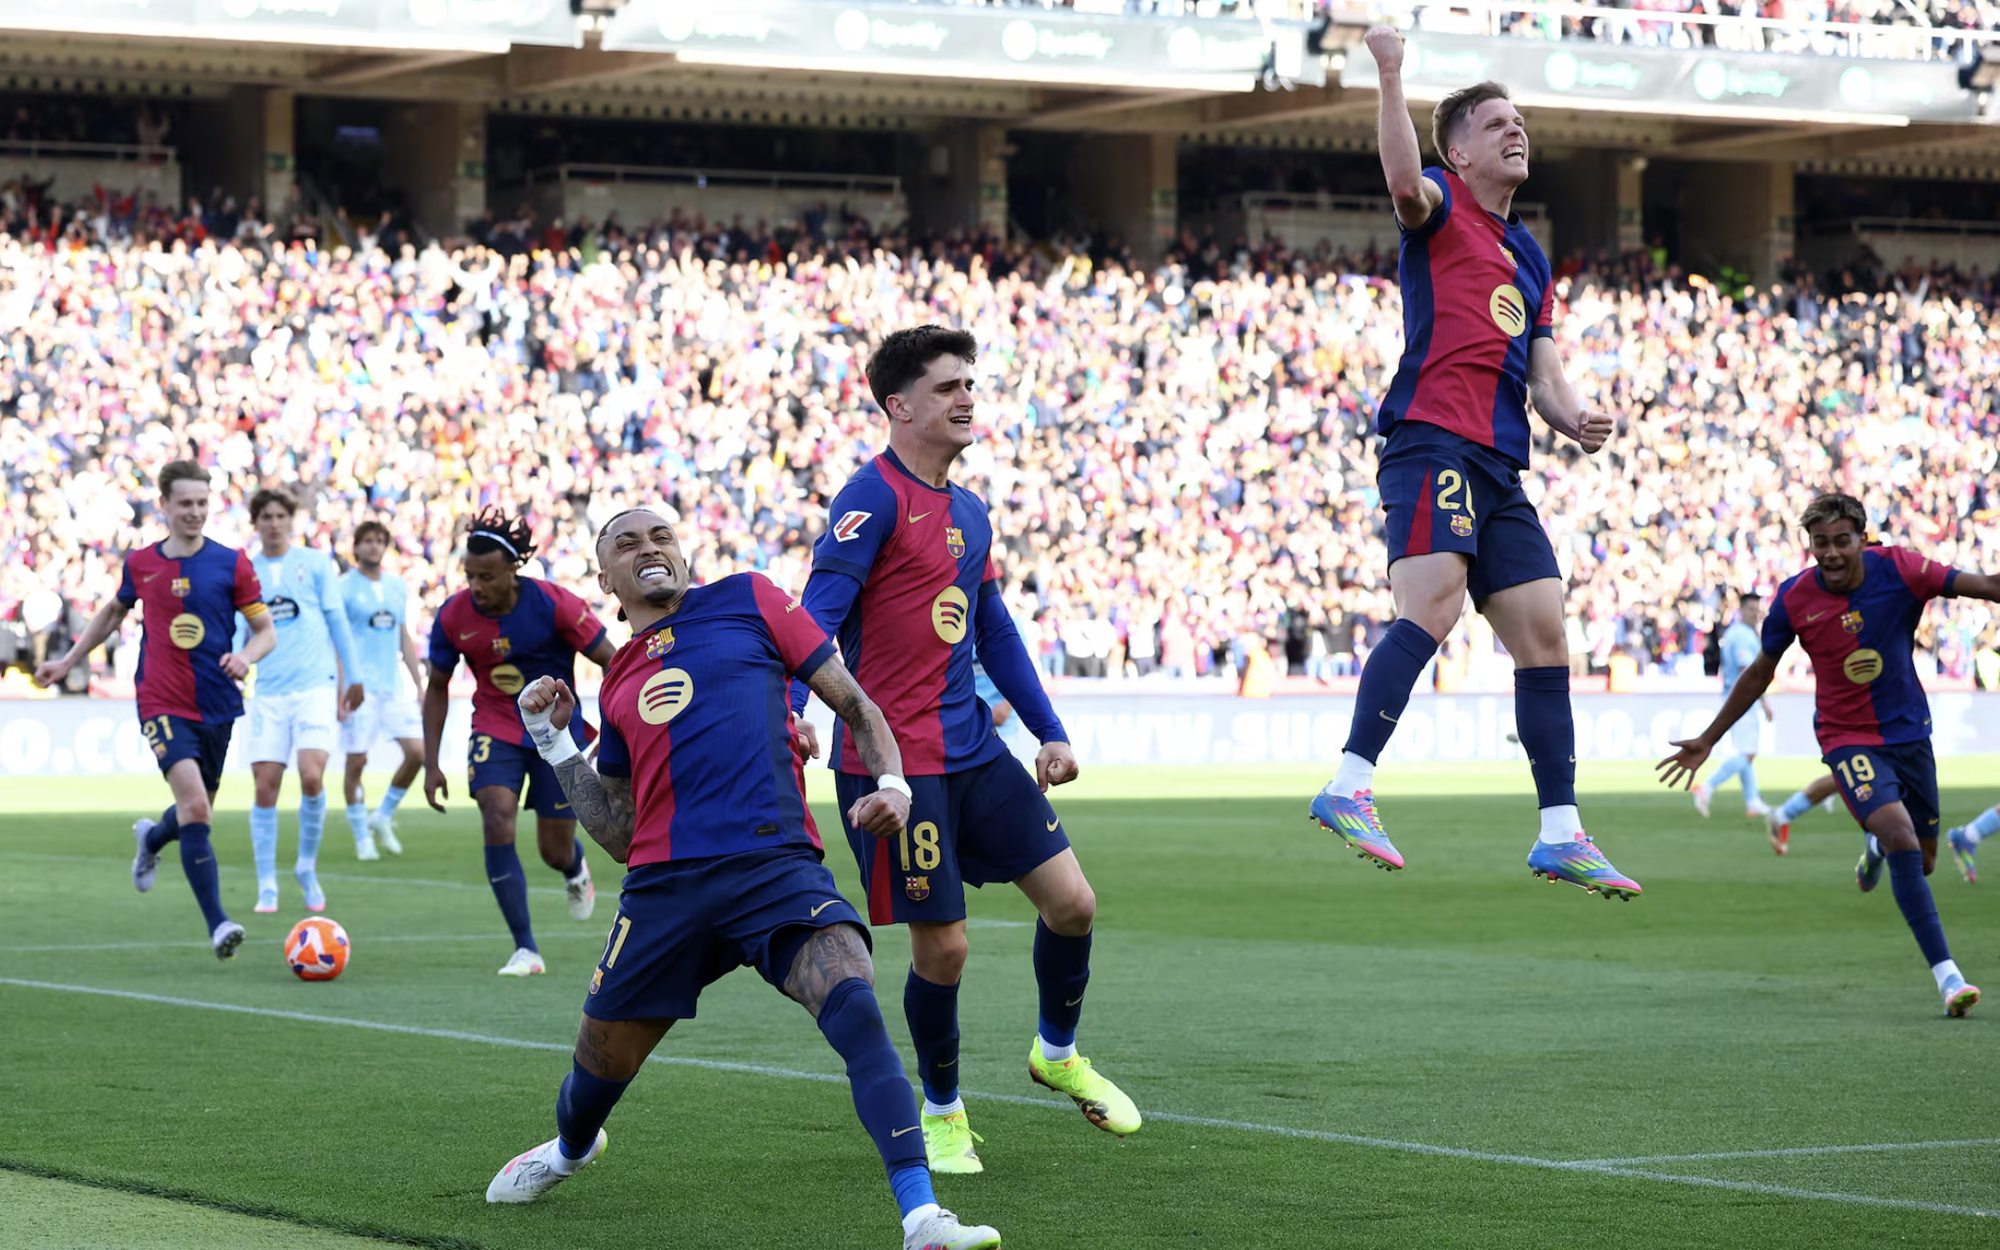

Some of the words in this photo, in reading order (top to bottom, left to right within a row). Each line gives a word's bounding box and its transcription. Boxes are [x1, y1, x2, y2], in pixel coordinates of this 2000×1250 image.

[0, 717, 239, 775] o.co
[143, 714, 174, 746] 21
[469, 735, 492, 763] 3
[1837, 754, 1876, 790] 19
[899, 820, 941, 871] 18
